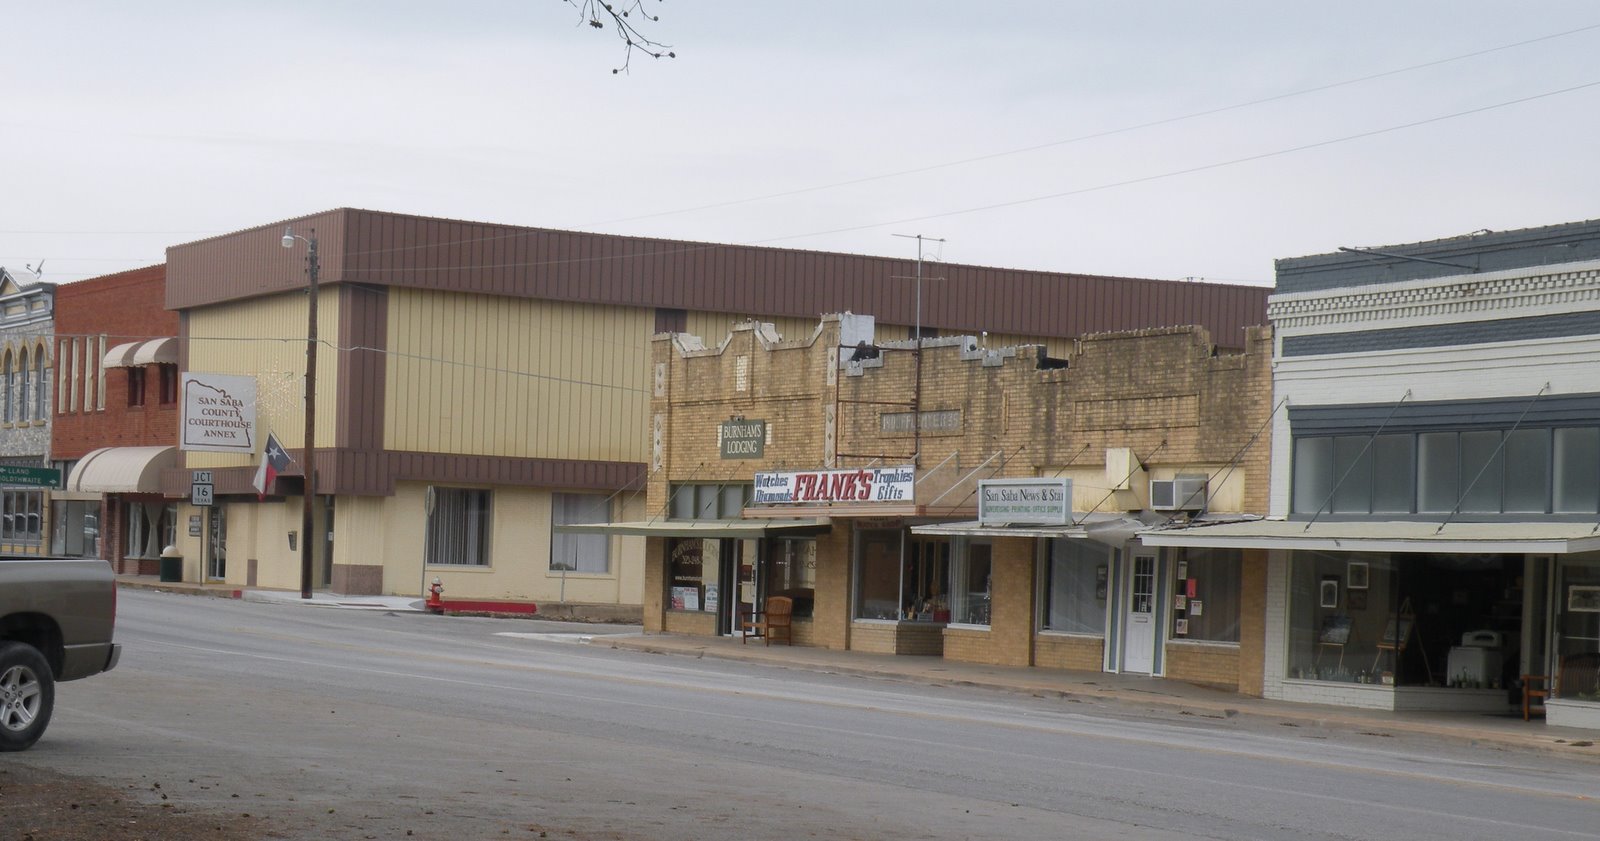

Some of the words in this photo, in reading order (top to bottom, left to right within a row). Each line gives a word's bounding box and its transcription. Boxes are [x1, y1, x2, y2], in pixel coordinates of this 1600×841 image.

[198, 397, 217, 405] SAN
[219, 398, 243, 407] SABA
[201, 408, 241, 417] COUNTY
[188, 418, 252, 429] COURTHOUSE
[203, 430, 236, 438] ANNEX
[723, 424, 762, 439] BURNHAM'S
[727, 440, 758, 454] LODGING
[0, 475, 42, 484] OLDTHWAITE
[195, 472, 211, 482] JCT
[755, 474, 788, 488] Watches
[872, 468, 913, 486] Trophies
[197, 487, 208, 497] 16
[791, 470, 874, 502] FRANK'S
[877, 485, 903, 500] Gifts
[755, 489, 792, 502] Diamonds
[986, 489, 999, 502] San
[1001, 488, 1018, 502] Saba
[1019, 488, 1040, 502] News
[1041, 488, 1047, 502] &
